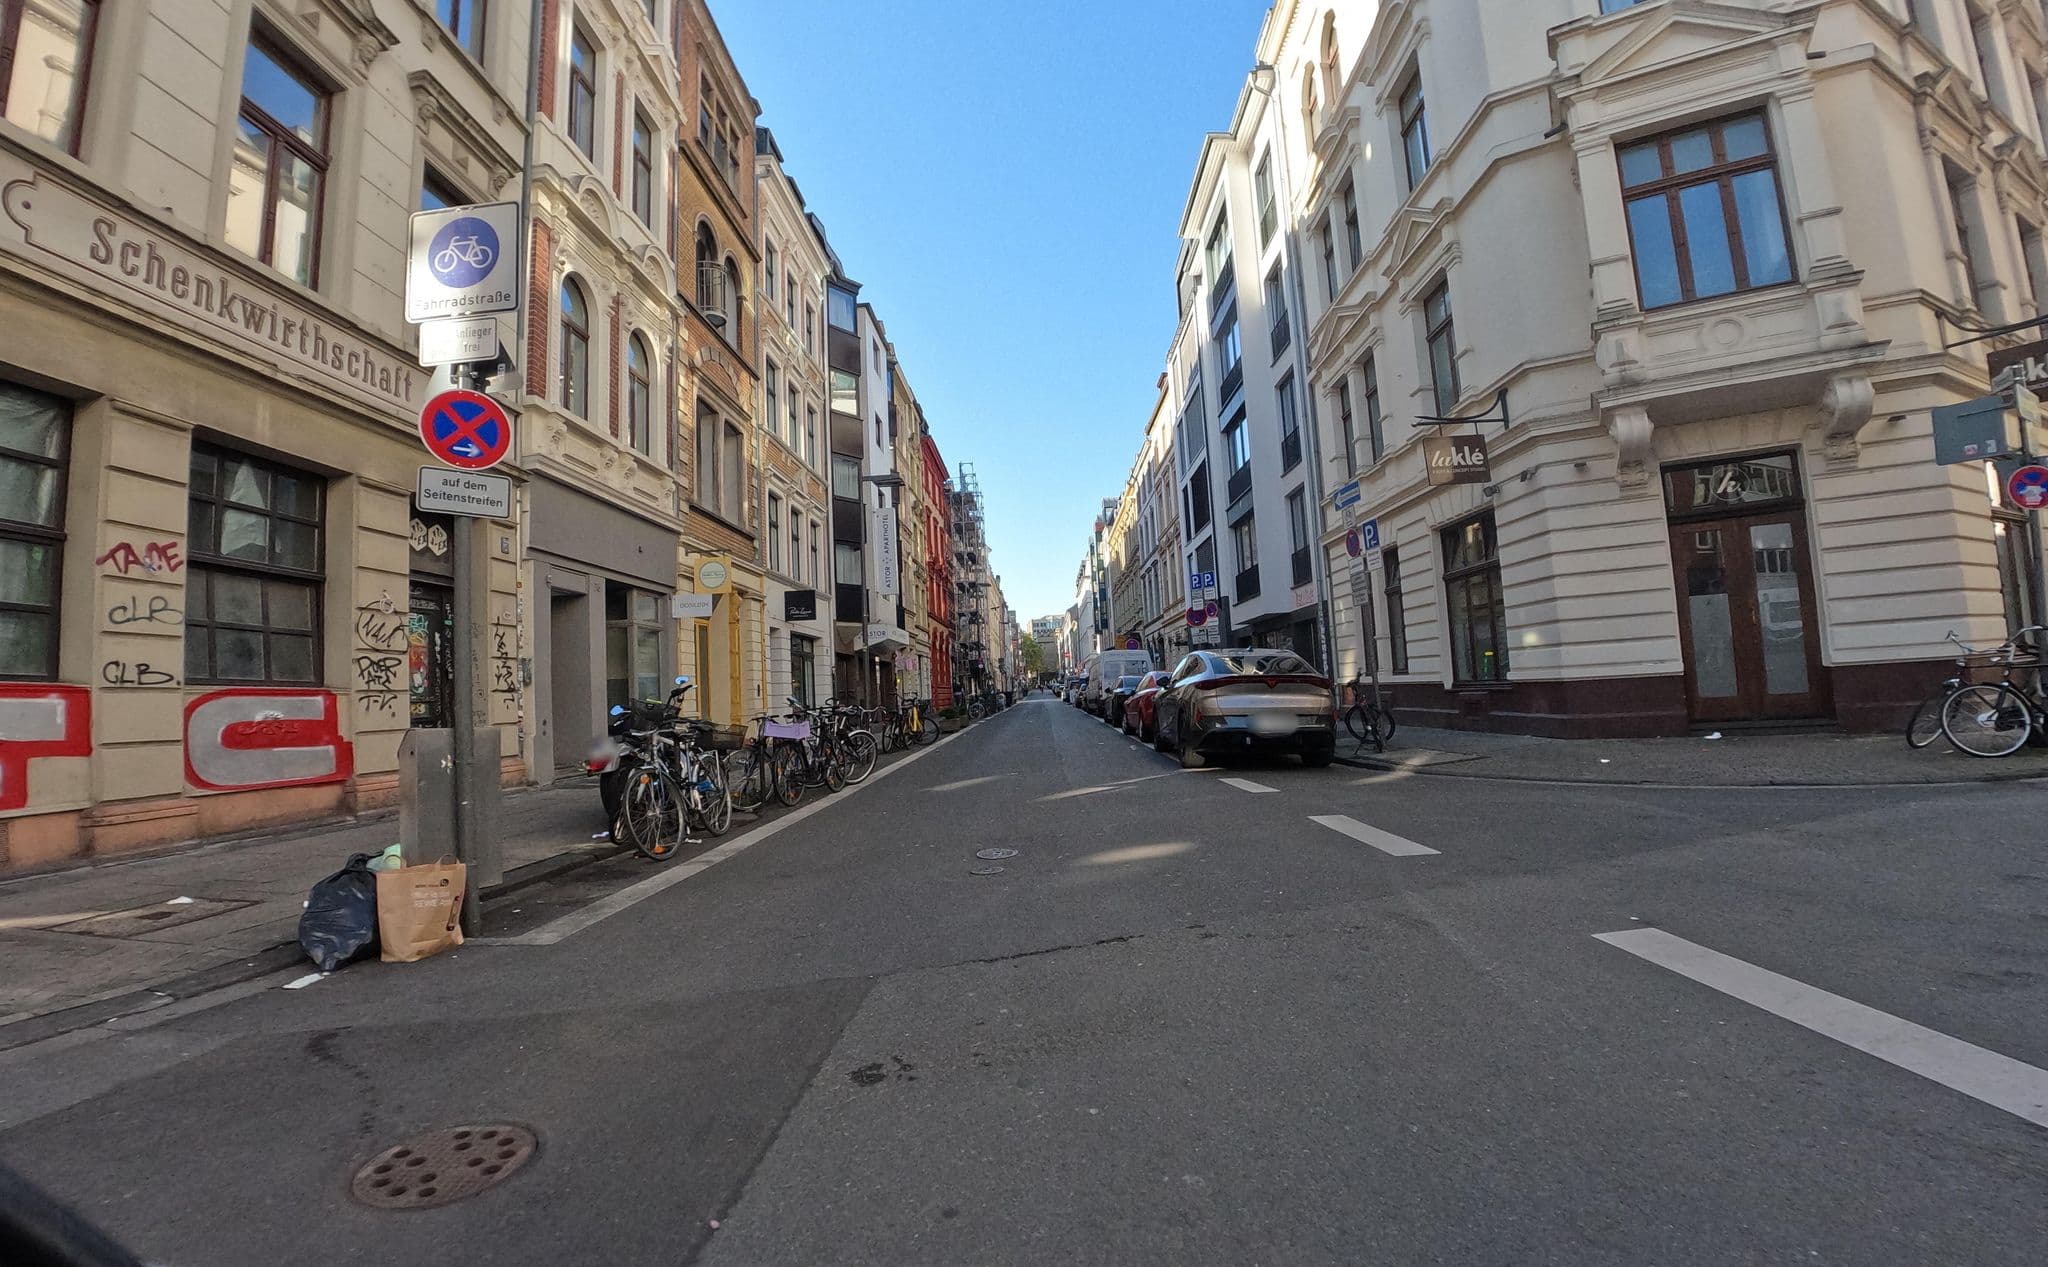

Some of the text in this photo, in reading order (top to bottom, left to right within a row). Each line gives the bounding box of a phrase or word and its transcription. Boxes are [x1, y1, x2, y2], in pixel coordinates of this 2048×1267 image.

[90, 216, 413, 402] Schenkwirthschaft
[463, 343, 480, 353] frei
[442, 478, 487, 491] auf dem
[423, 488, 503, 508] Seitenstreifen
[1364, 524, 1374, 550] P
